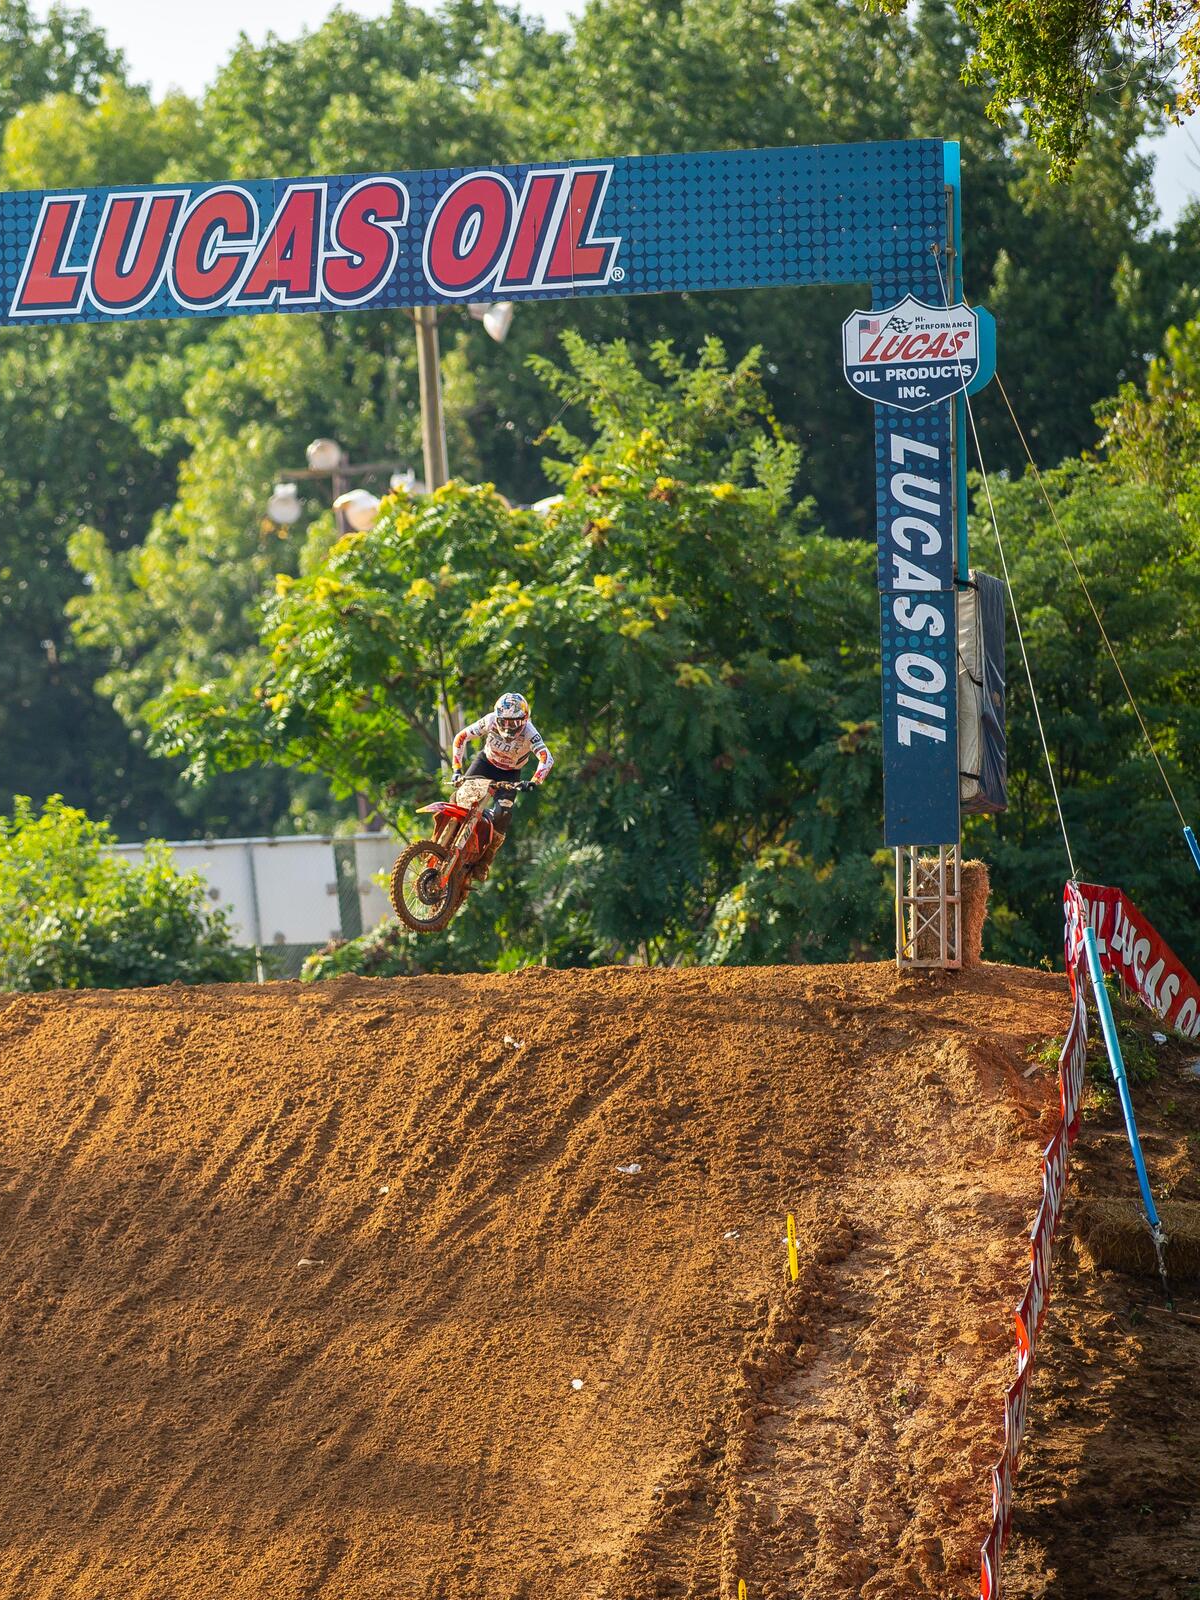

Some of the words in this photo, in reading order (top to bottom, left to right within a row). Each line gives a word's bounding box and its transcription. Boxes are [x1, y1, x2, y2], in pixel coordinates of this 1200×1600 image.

[8, 177, 410, 316] LUCAS
[423, 165, 621, 297] OIL
[858, 331, 970, 362] LUCAS
[914, 321, 973, 331] PERFORMANCE
[852, 370, 880, 383] OIL
[885, 364, 972, 382] PRODUCTS
[897, 386, 930, 399] INC.
[889, 433, 946, 637] LUCAS
[894, 652, 947, 747] OIL
[1110, 902, 1180, 1019] LUCAS
